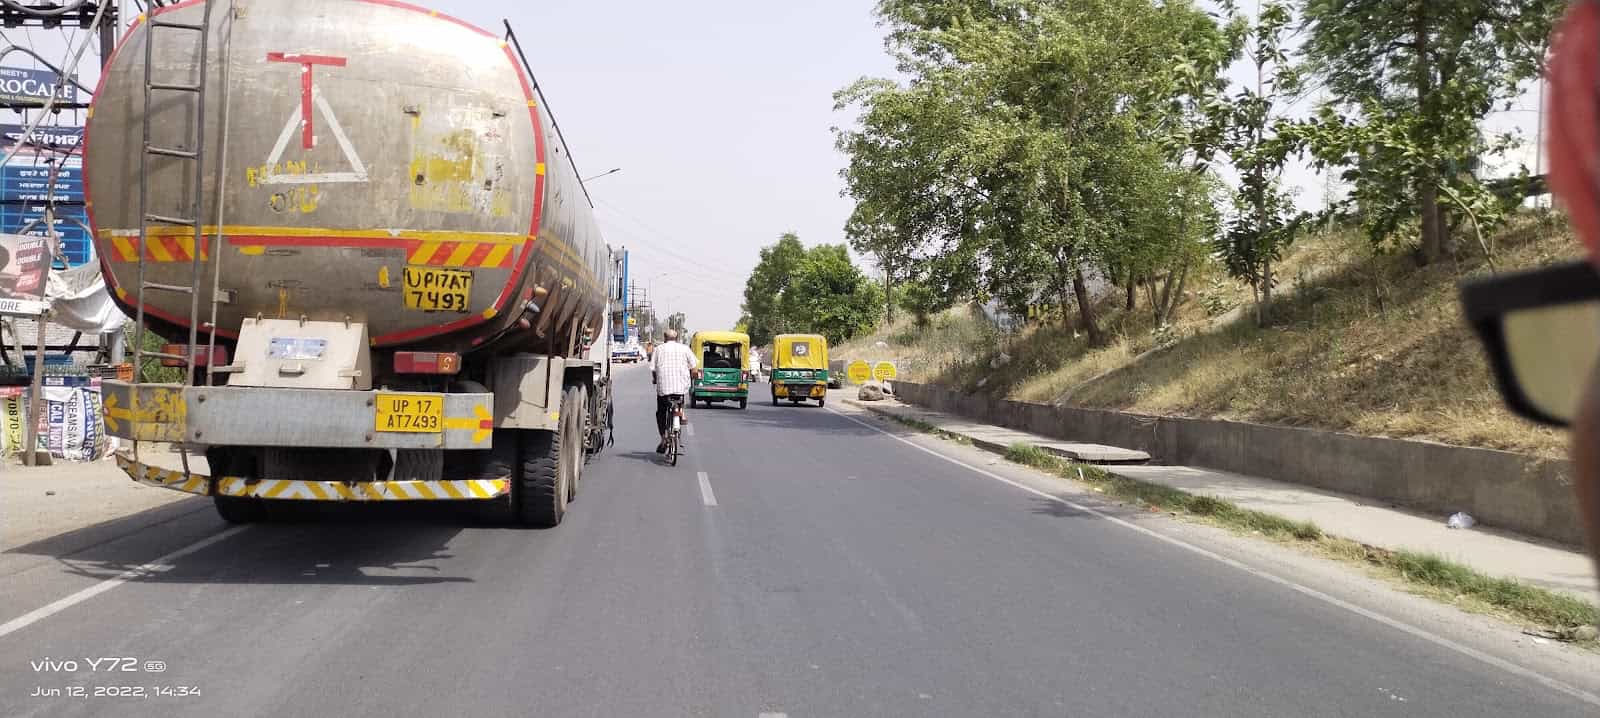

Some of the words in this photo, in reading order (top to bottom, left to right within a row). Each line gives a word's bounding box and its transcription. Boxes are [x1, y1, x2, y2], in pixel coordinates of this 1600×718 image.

[411, 291, 465, 314] 7493
[393, 400, 409, 412] UP
[417, 400, 432, 413] 17
[387, 415, 438, 429] AT7493
